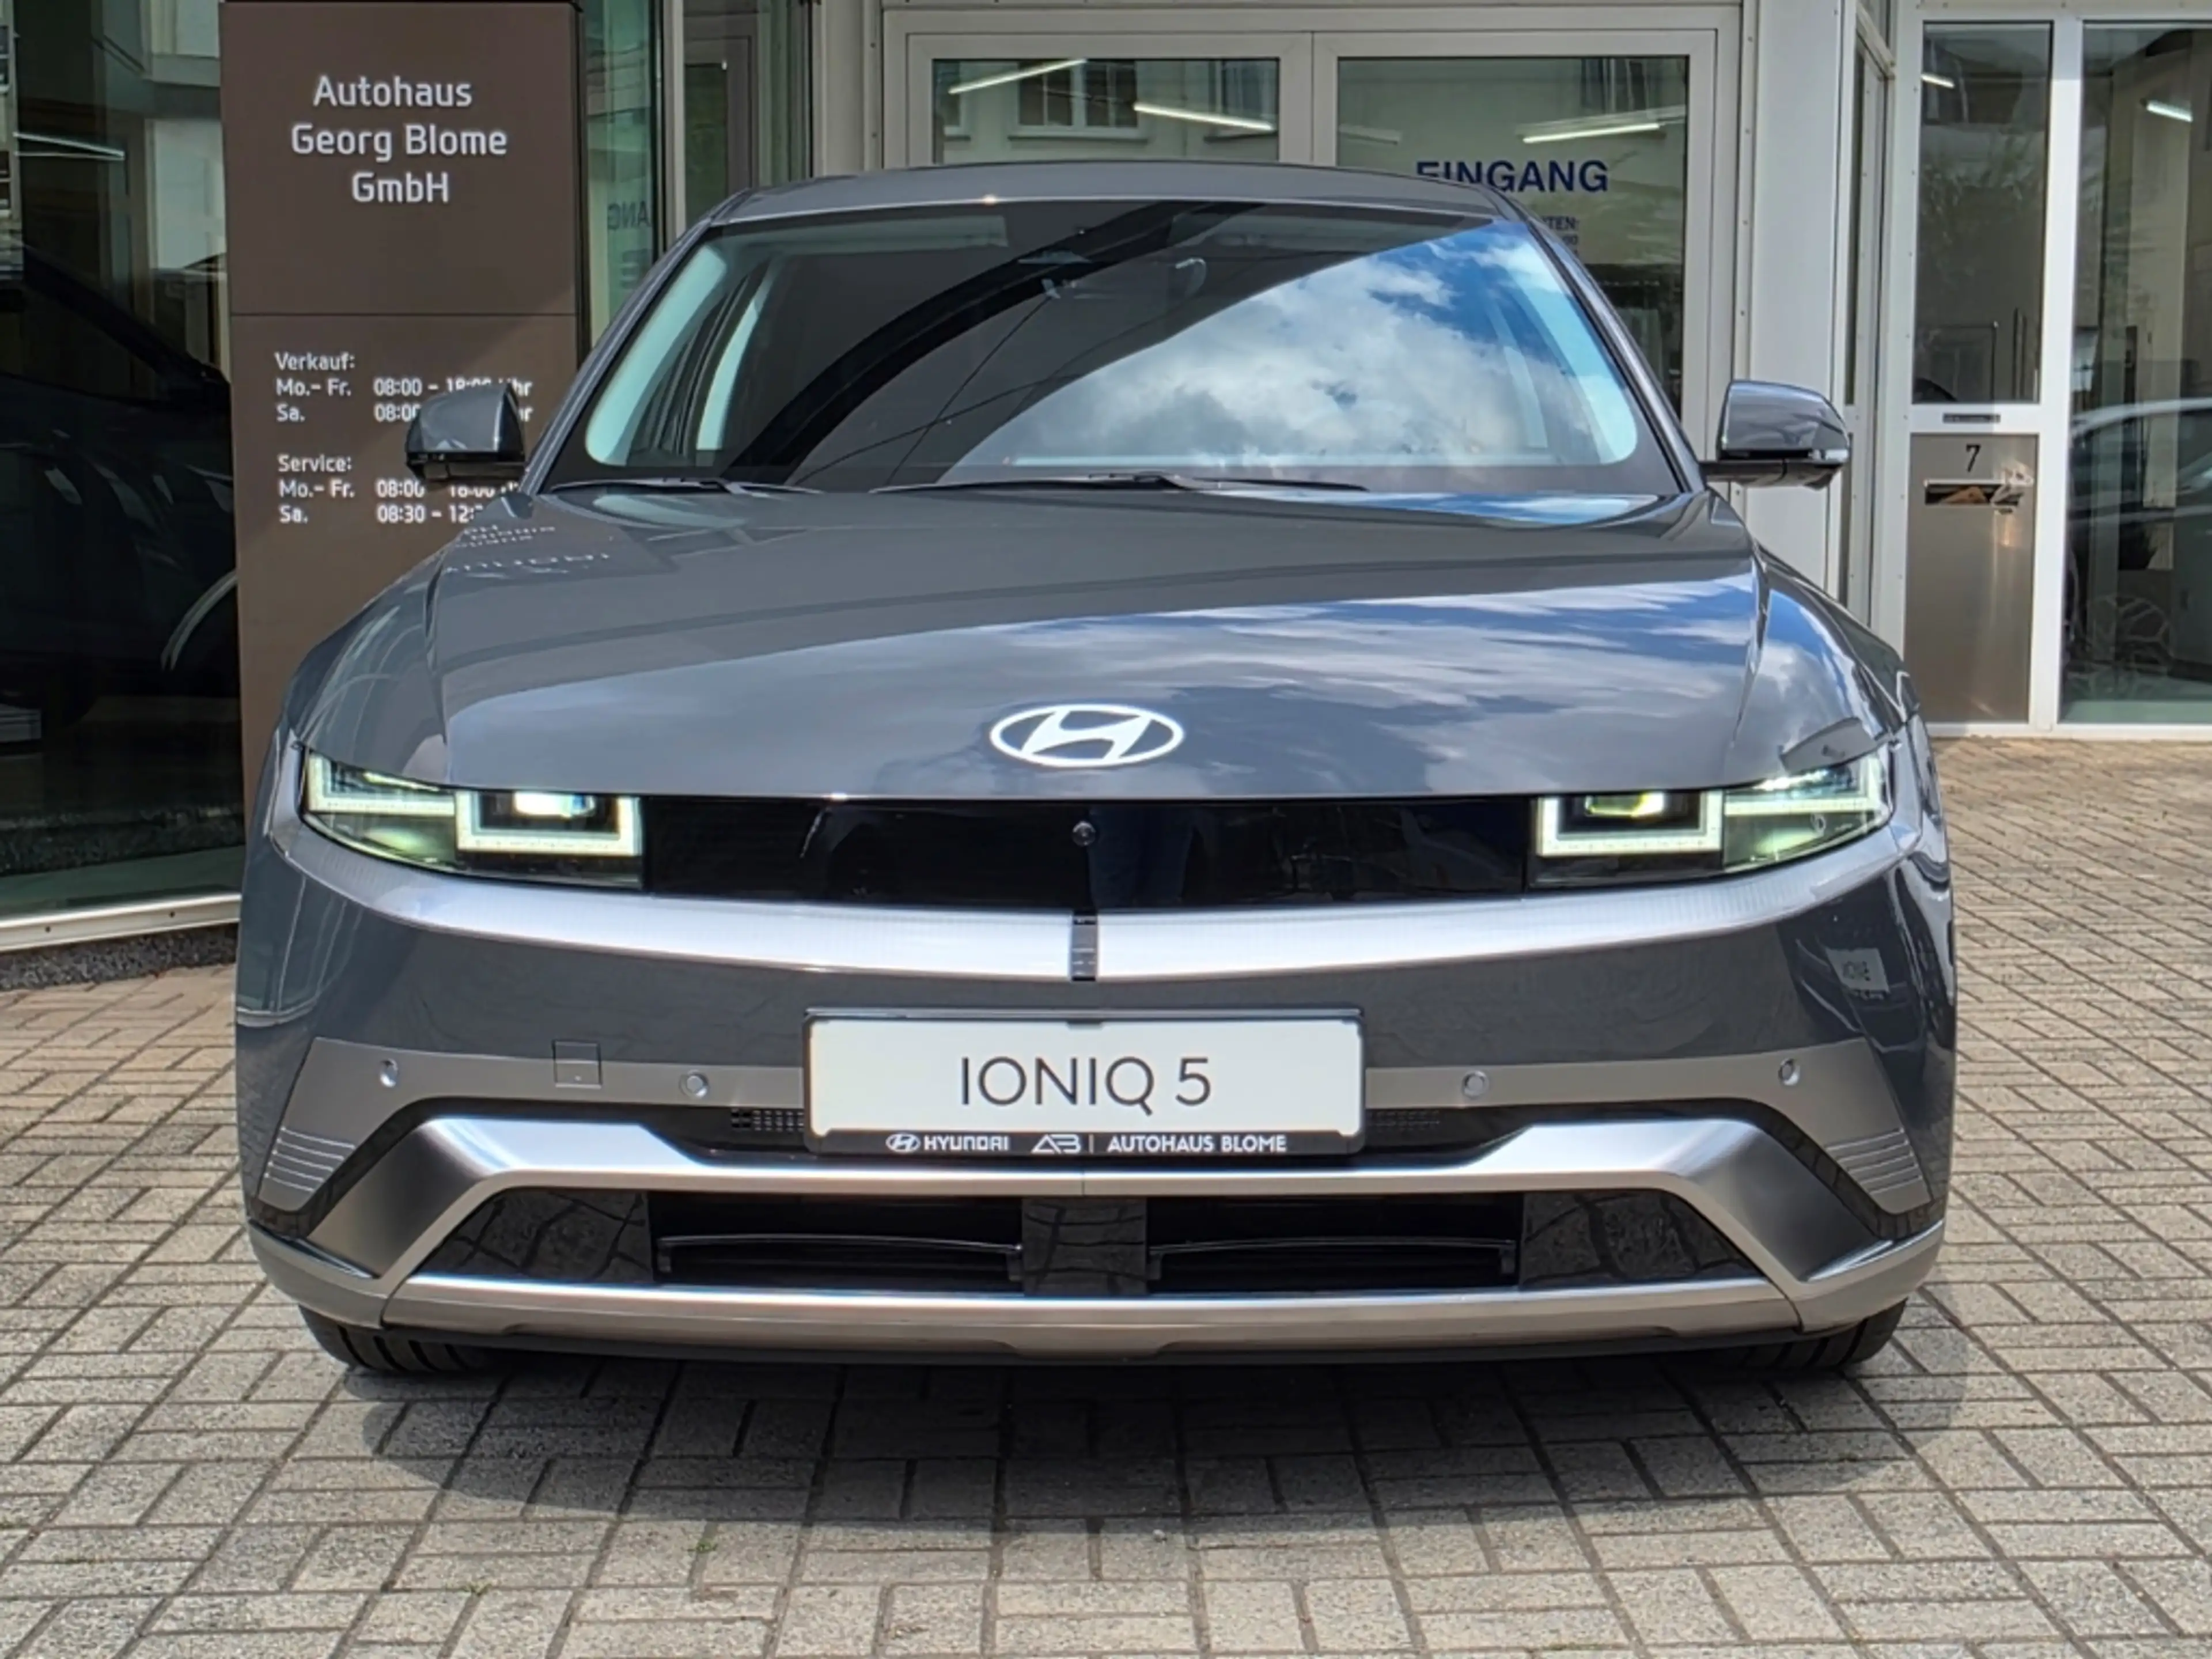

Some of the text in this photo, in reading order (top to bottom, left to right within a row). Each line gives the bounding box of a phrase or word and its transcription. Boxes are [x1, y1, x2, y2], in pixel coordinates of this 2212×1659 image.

[313, 75, 472, 107] Autohaus
[291, 124, 507, 161] Georg Blome
[351, 172, 449, 203] GmbH
[274, 351, 355, 370] Verkauf:
[327, 377, 352, 396] Fr.
[373, 378, 422, 396] 08:00
[276, 403, 305, 422] Sa.
[278, 454, 352, 472] Service:
[1965, 444, 1982, 473] 7
[330, 479, 355, 498] Fr.
[377, 479, 425, 498] 08:00
[279, 505, 308, 523] Sa.
[377, 505, 425, 523] 08:30
[961, 1056, 1211, 1116] IONIQ 5
[924, 1135, 1009, 1152] HYUNDAI
[1107, 1135, 1214, 1153] AUTOHAUS
[1221, 1135, 1287, 1153] BLOME
